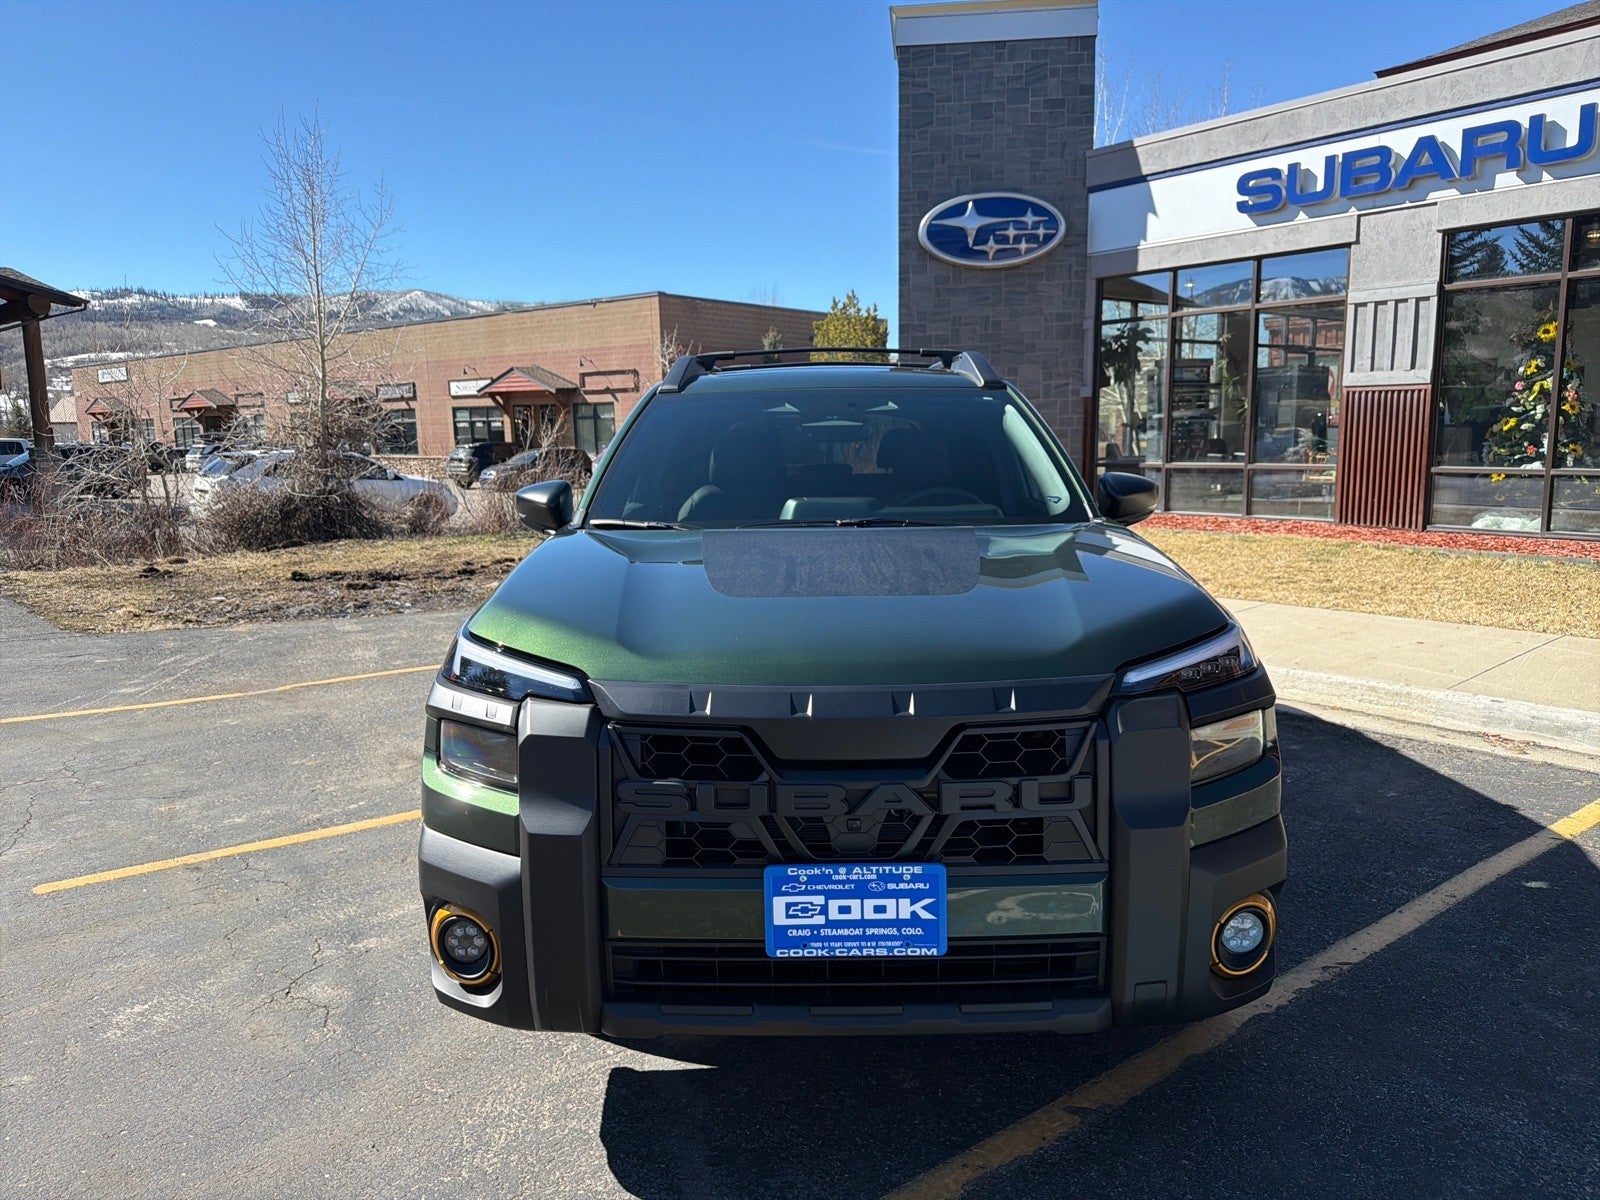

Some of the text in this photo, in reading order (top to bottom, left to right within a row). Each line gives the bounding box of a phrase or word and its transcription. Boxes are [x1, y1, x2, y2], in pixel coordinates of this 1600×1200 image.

[1236, 102, 1599, 214] SUBARU
[617, 774, 1093, 817] SUBARU
[788, 867, 833, 875] Cook'n
[852, 866, 923, 874] ALTITUDE
[887, 882, 930, 890] SUBARU
[772, 895, 938, 926] COOK
[820, 928, 864, 936] STEAMBOAT
[865, 927, 899, 936] SPRINGS,
[901, 927, 924, 935] COLO.
[776, 947, 938, 957] COOK-CARS.COM
